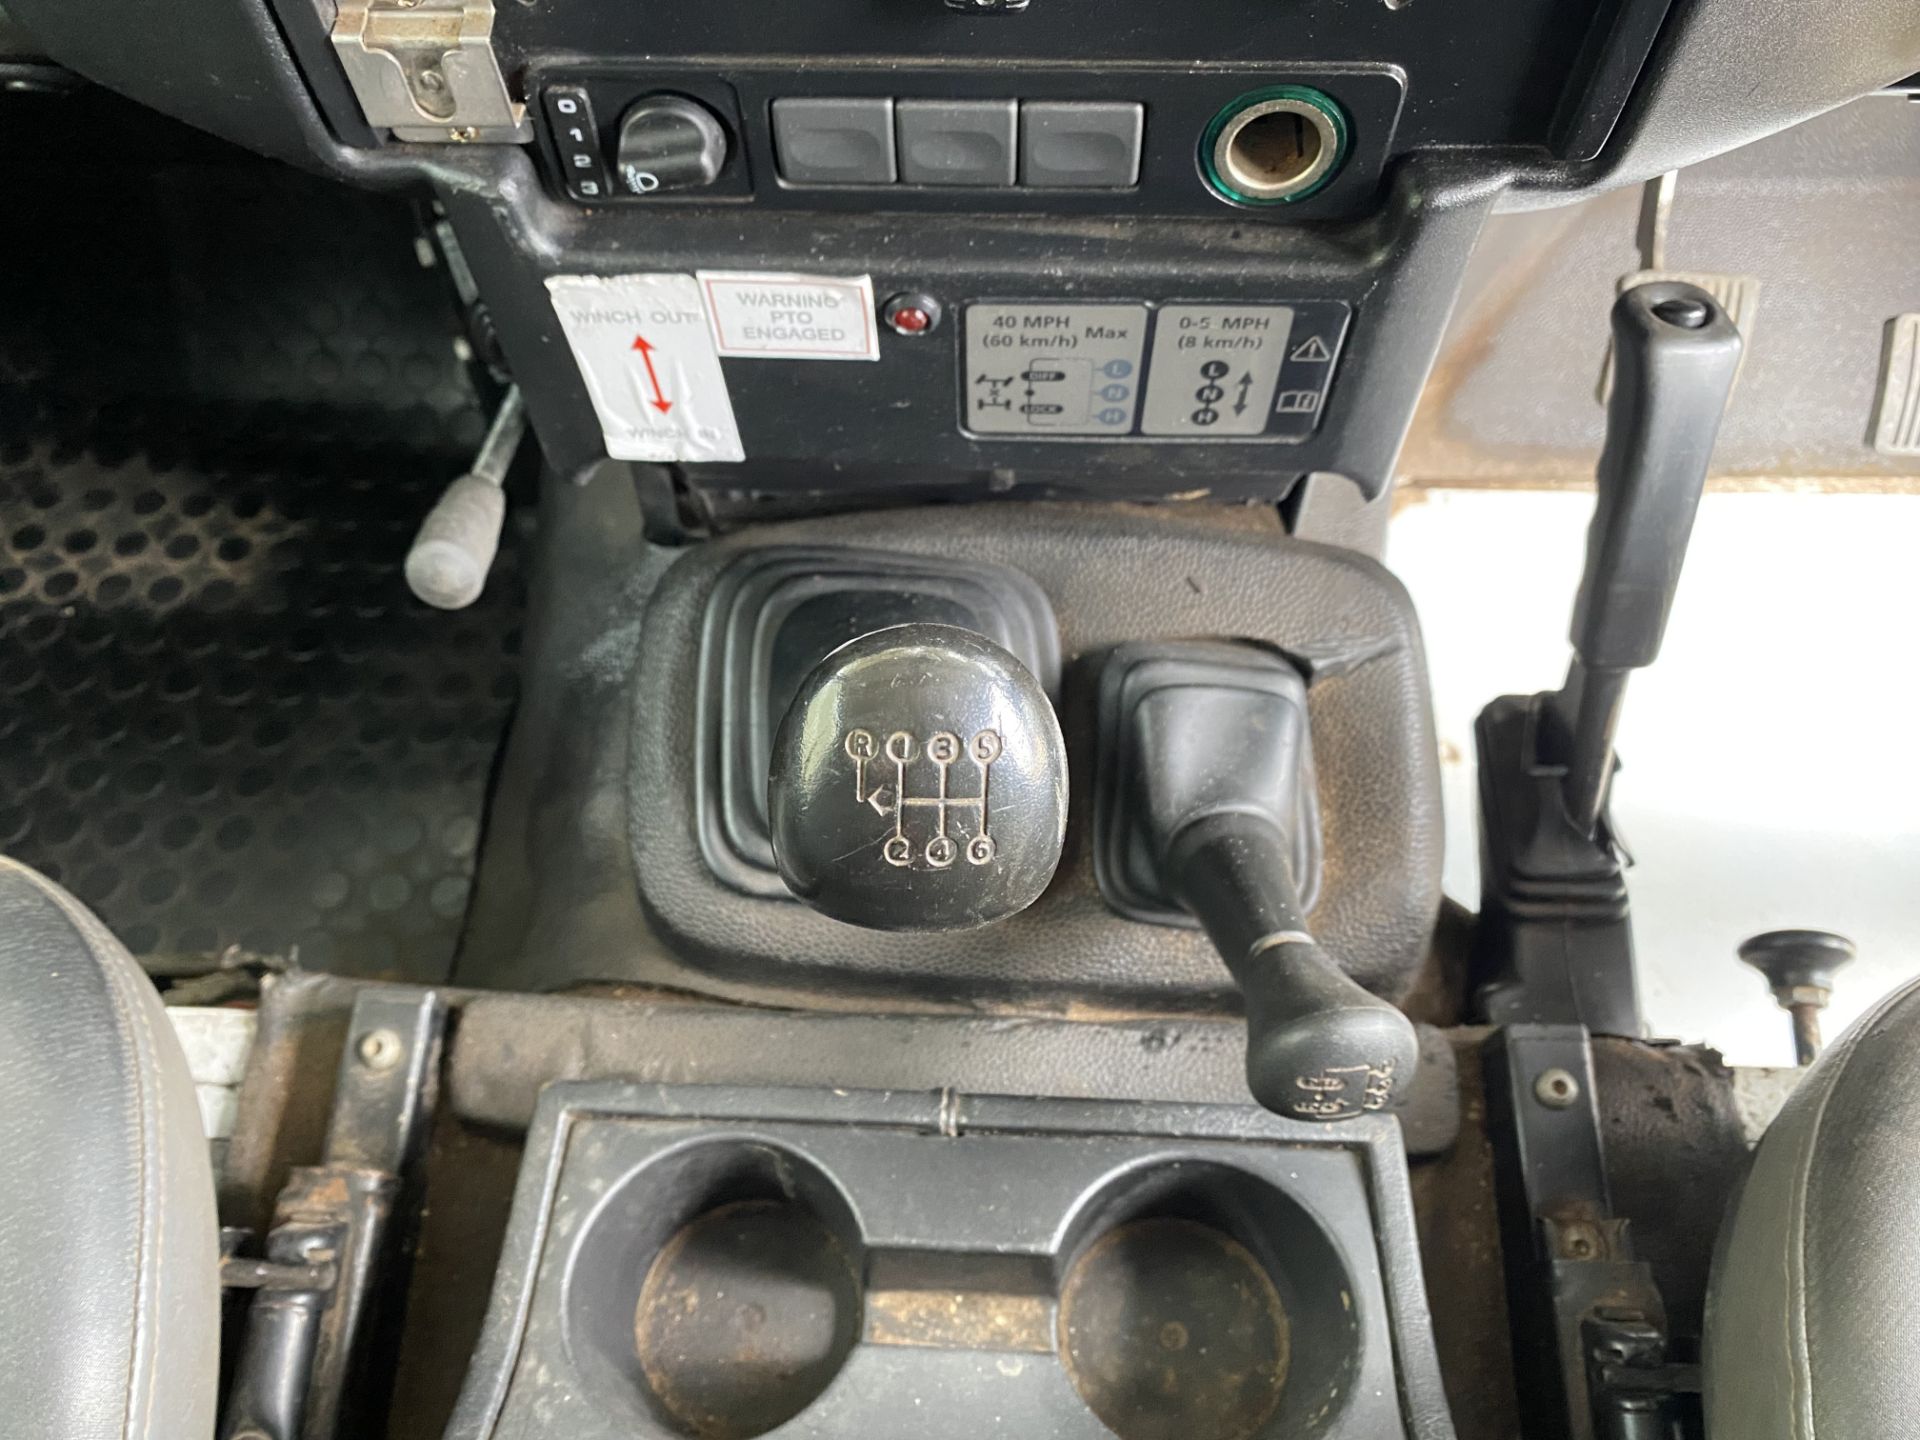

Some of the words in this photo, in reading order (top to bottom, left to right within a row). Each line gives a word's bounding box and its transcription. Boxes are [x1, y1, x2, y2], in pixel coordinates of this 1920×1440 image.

[557, 99, 577, 114] 0
[569, 128, 583, 142] 1
[573, 154, 592, 168] 2
[580, 181, 599, 195] 3
[736, 292, 839, 308] WARNING
[569, 309, 642, 324] WINCH
[770, 311, 813, 324] PTO
[992, 316, 1017, 328] 40
[1023, 316, 1070, 328] MPH
[1179, 317, 1210, 329] 0-5
[1222, 317, 1270, 329] MPH
[743, 327, 845, 341] ENGAGED
[1085, 326, 1128, 339] Max
[982, 334, 1013, 348] (60
[1020, 334, 1078, 348] km/h)
[1178, 336, 1197, 349] (8
[1203, 336, 1263, 349] km/h)
